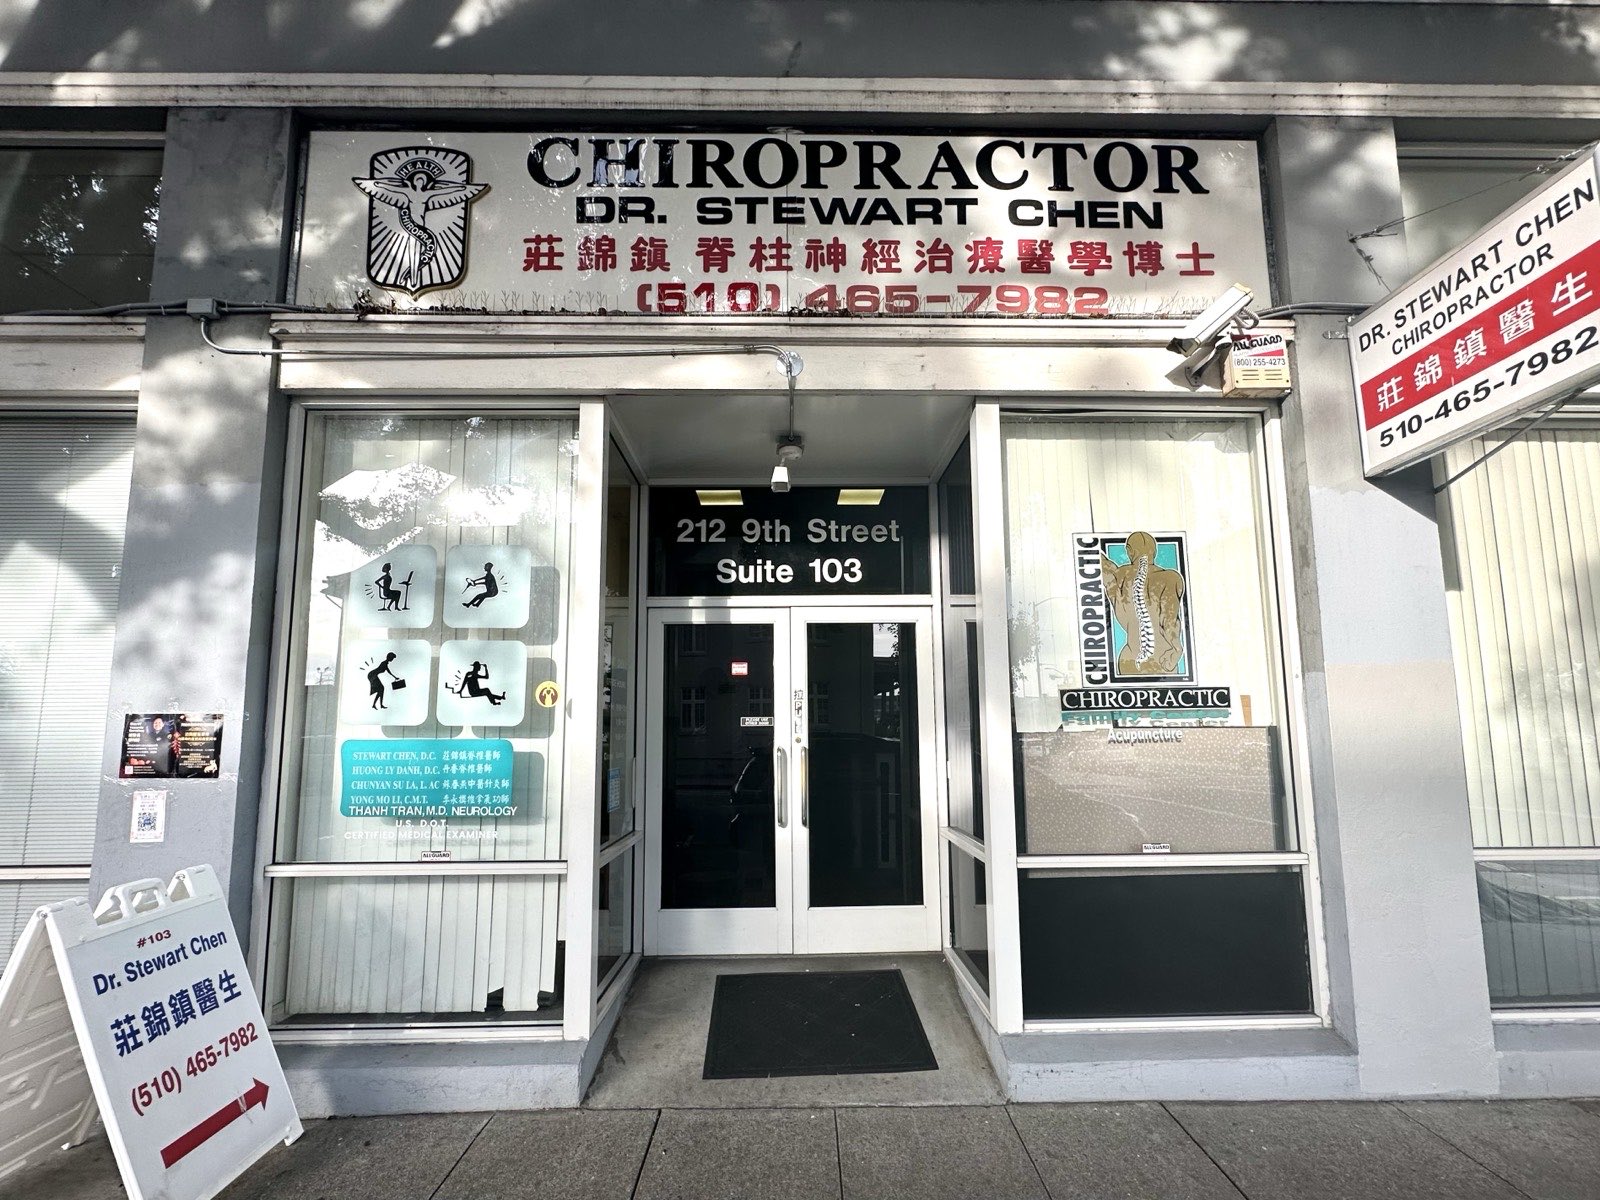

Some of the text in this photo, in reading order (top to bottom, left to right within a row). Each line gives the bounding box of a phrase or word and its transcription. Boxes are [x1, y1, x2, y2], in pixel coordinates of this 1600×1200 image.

[400, 161, 440, 176] HEALTH
[526, 136, 1210, 195] CHIROPRACTOR
[576, 196, 1163, 229] DR. STEWART CHEN
[1359, 178, 1595, 353] DR. STEWART CHEN
[636, 281, 1109, 315] (510) 465-7982
[1391, 242, 1555, 356] CHIROPRACTOR
[1379, 325, 1600, 448] 510-465-7982
[676, 518, 900, 543] 212 9th Street
[716, 558, 863, 584] Suite 103
[1076, 537, 1108, 685] CHIROPRACTIC
[1062, 688, 1229, 708] CHIROPRACTIC
[1107, 728, 1183, 743] Acupuncture
[353, 752, 436, 761] STEWART CHEN, D.C.
[352, 766, 440, 776] HUONG LY DANH, D.C.
[351, 781, 440, 790] CHUNYAN SU LA, L. AC
[349, 806, 387, 816] THANH
[451, 806, 518, 816] NEUROLOGY
[351, 796, 374, 804] YONG
[376, 796, 390, 804] MO
[404, 796, 428, 804] C.M.T.
[344, 830, 498, 840] CERTIFIED MEDICAL EXAMINER
[395, 820, 449, 828] U.S. D.O.T.
[136, 929, 172, 949] #103
[92, 931, 228, 996] Dr. Stewart Chen
[131, 1022, 259, 1117] (510) 465-7982
